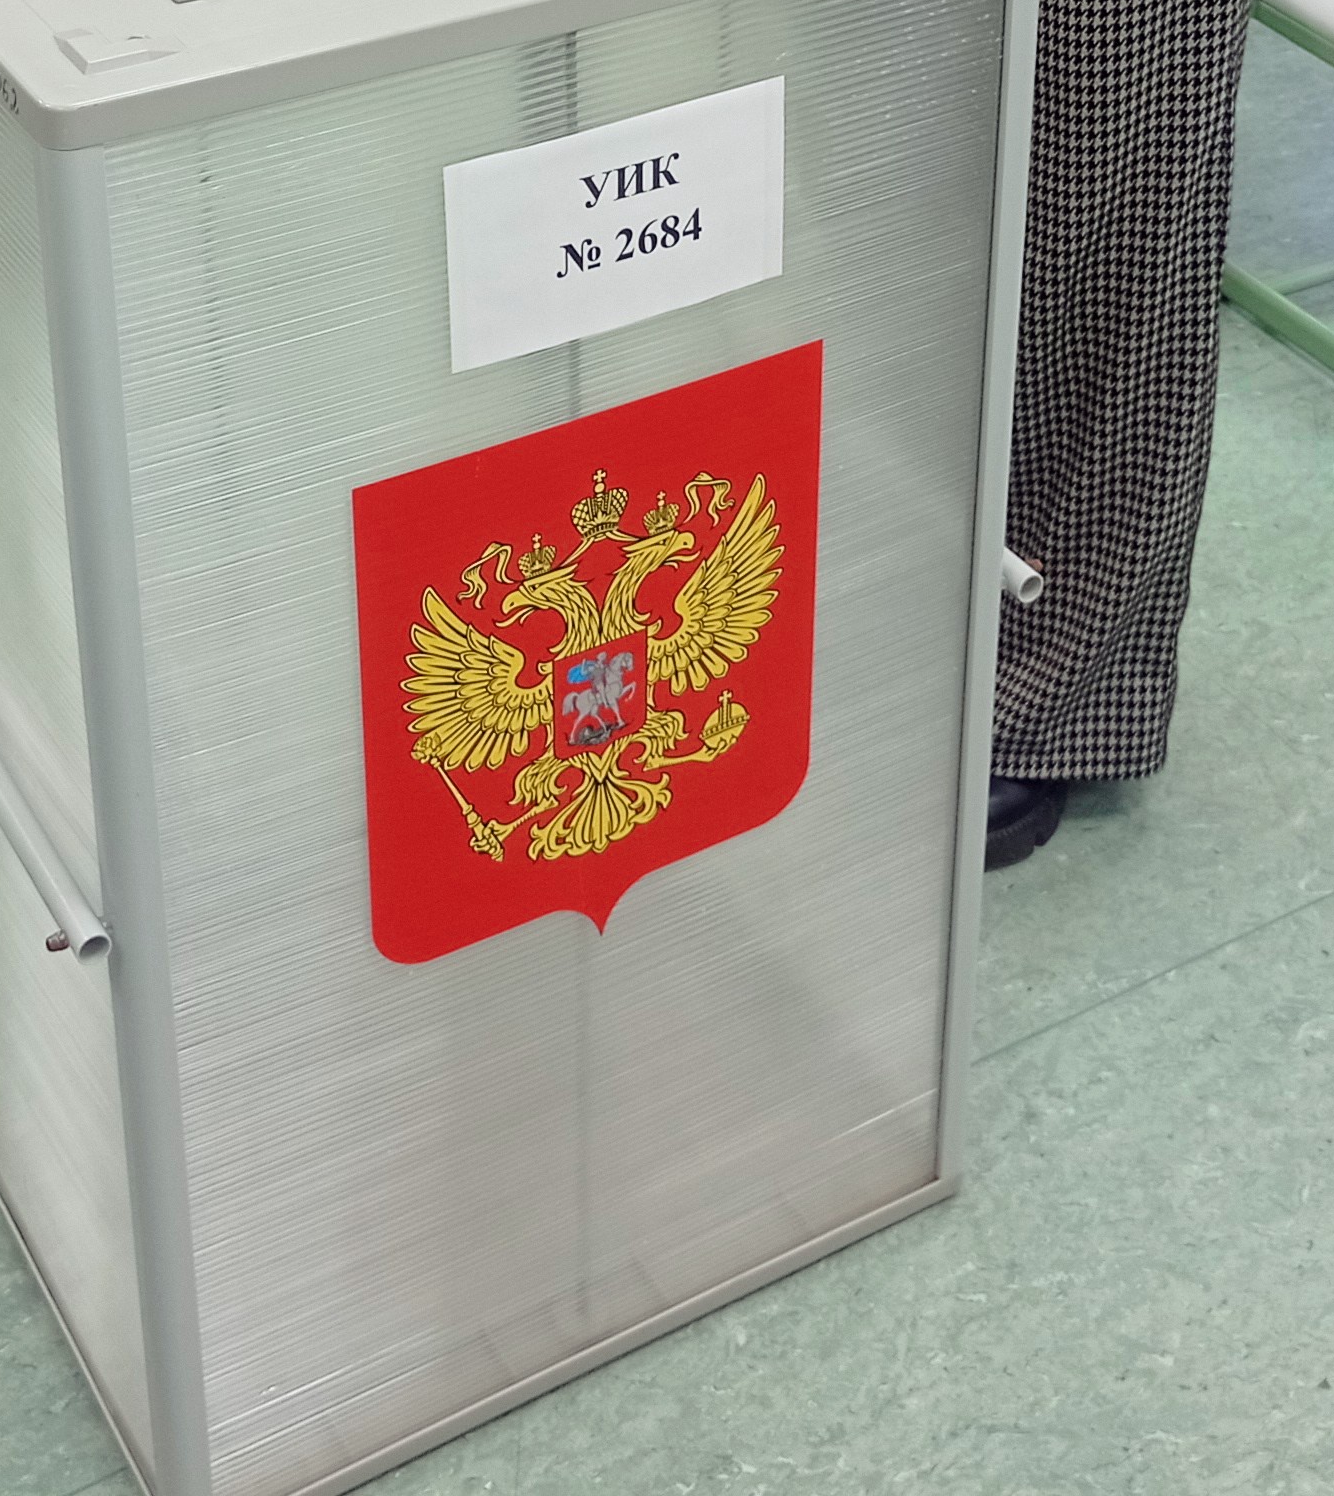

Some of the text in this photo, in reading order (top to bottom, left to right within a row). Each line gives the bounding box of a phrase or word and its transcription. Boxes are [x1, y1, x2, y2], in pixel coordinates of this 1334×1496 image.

[578, 151, 681, 209] УИК
[556, 206, 703, 279] № 2684
